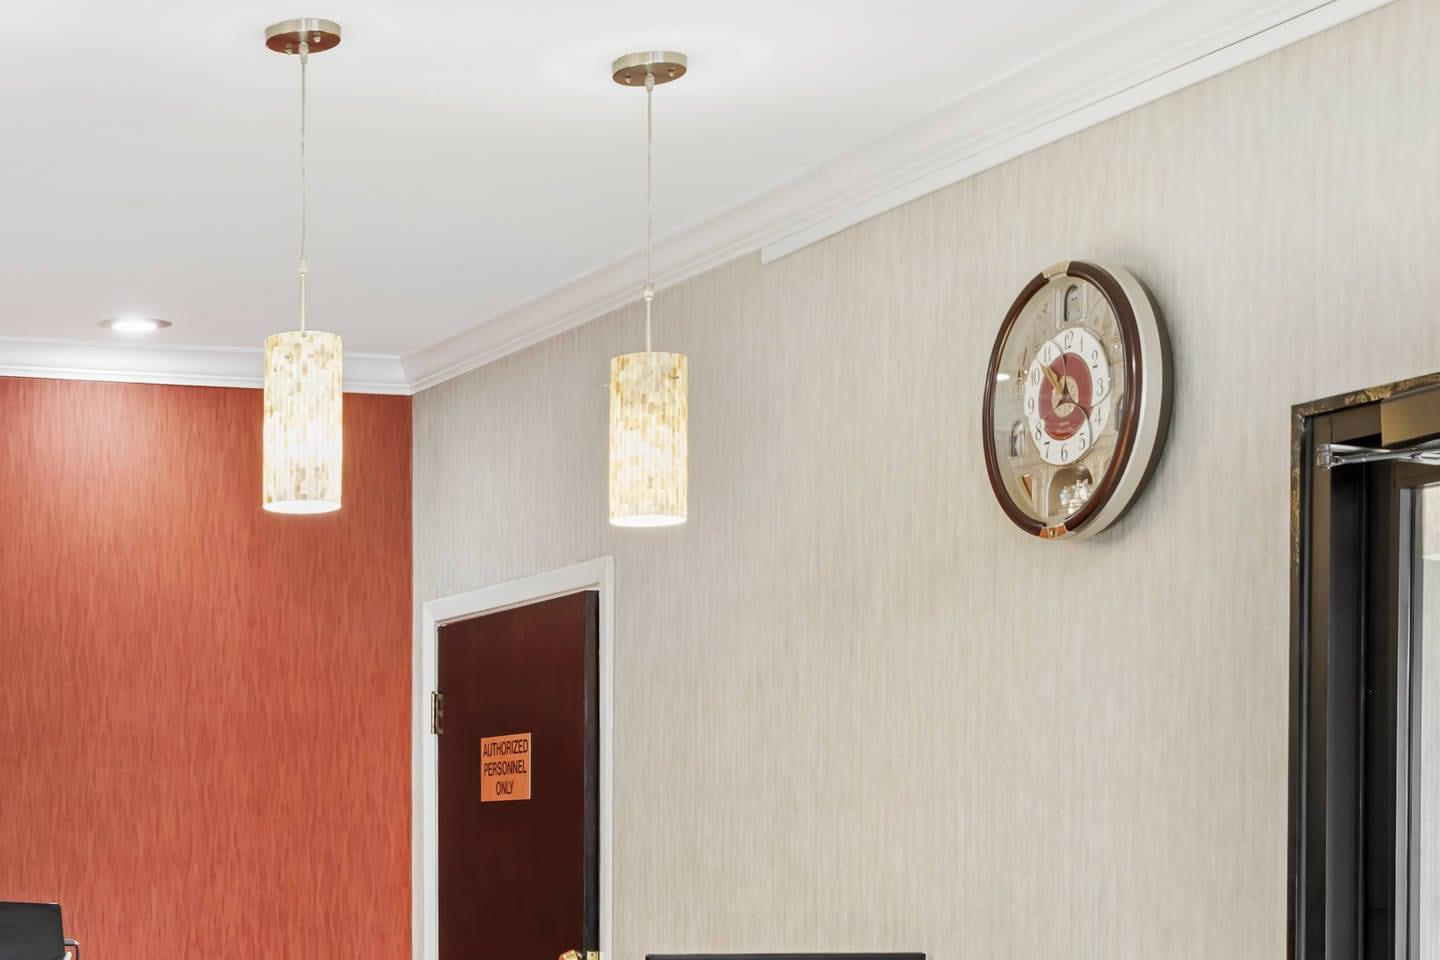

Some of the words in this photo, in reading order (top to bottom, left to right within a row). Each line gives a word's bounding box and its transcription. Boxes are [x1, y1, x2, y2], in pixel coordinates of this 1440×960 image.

[1064, 330, 1074, 350] 12
[1043, 344, 1051, 363] 11
[1091, 350, 1099, 369] 2
[1031, 367, 1040, 386] 10
[1097, 377, 1104, 397] 3
[1027, 397, 1035, 415] 9
[1094, 407, 1102, 425] 4
[1035, 423, 1042, 441] 8
[1078, 432, 1086, 450] 5
[1044, 441, 1050, 459] 7
[1061, 443, 1068, 461] 6
[483, 739, 528, 757] AUTHORIZED
[484, 760, 527, 777] PERSONNEL
[495, 780, 514, 796] ONLY
